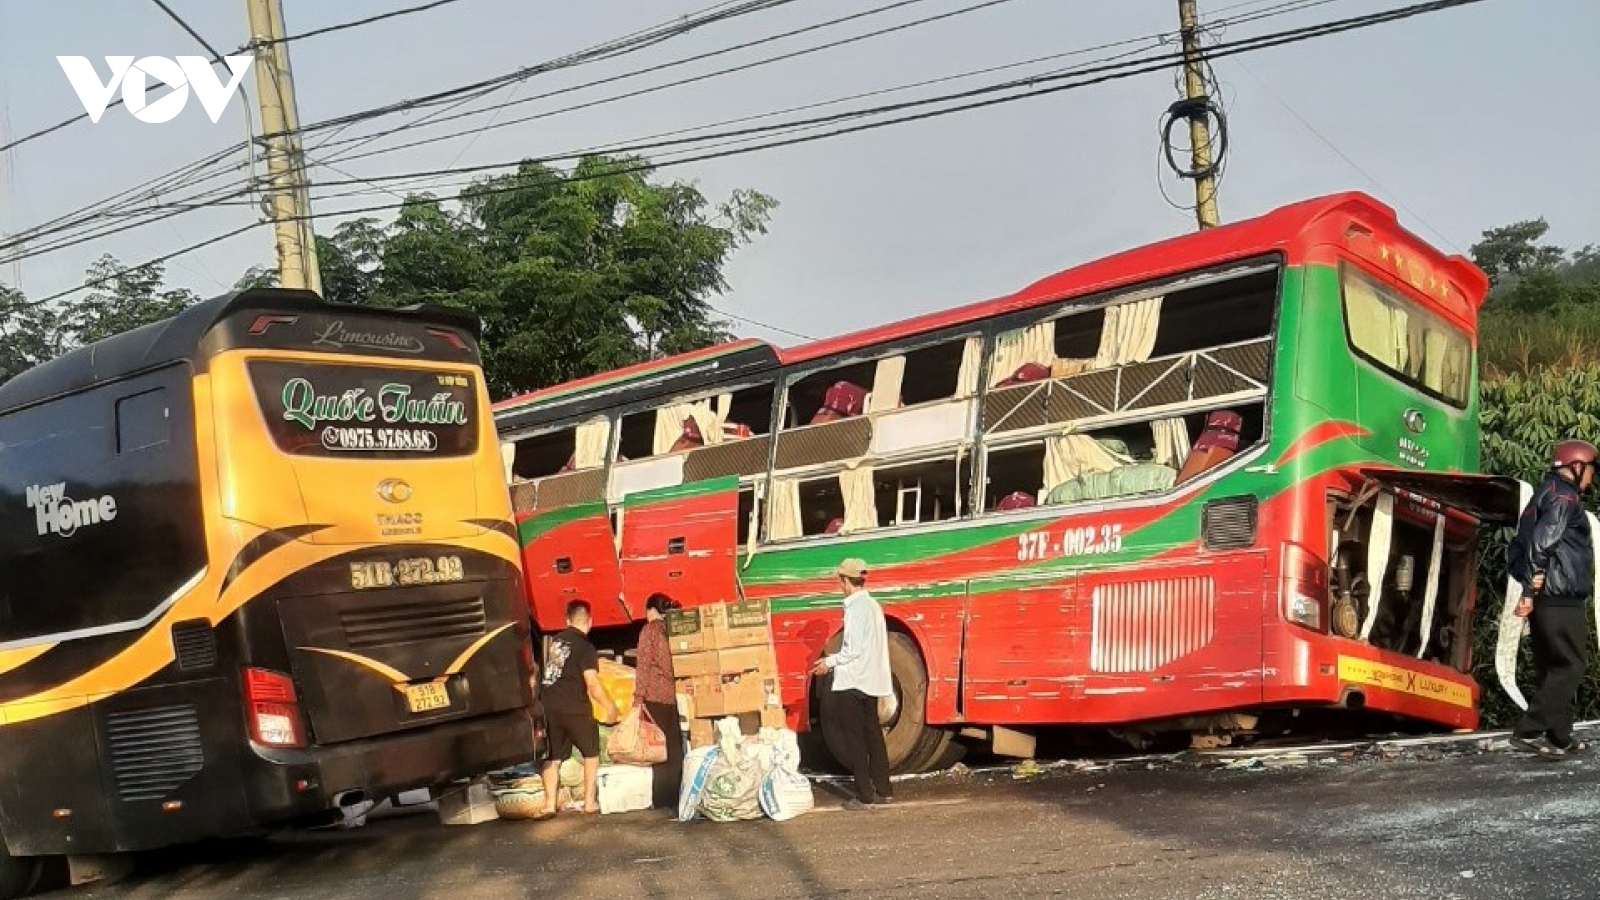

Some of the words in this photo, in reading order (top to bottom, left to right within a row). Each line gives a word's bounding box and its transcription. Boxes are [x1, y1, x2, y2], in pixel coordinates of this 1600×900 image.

[311, 319, 424, 353] Limousine
[281, 377, 376, 431] Quốc
[378, 383, 468, 425] Tuấn
[26, 481, 66, 508] New
[36, 494, 118, 538] Home
[1017, 531, 1050, 561] 37F
[1063, 523, 1122, 557] 002.35
